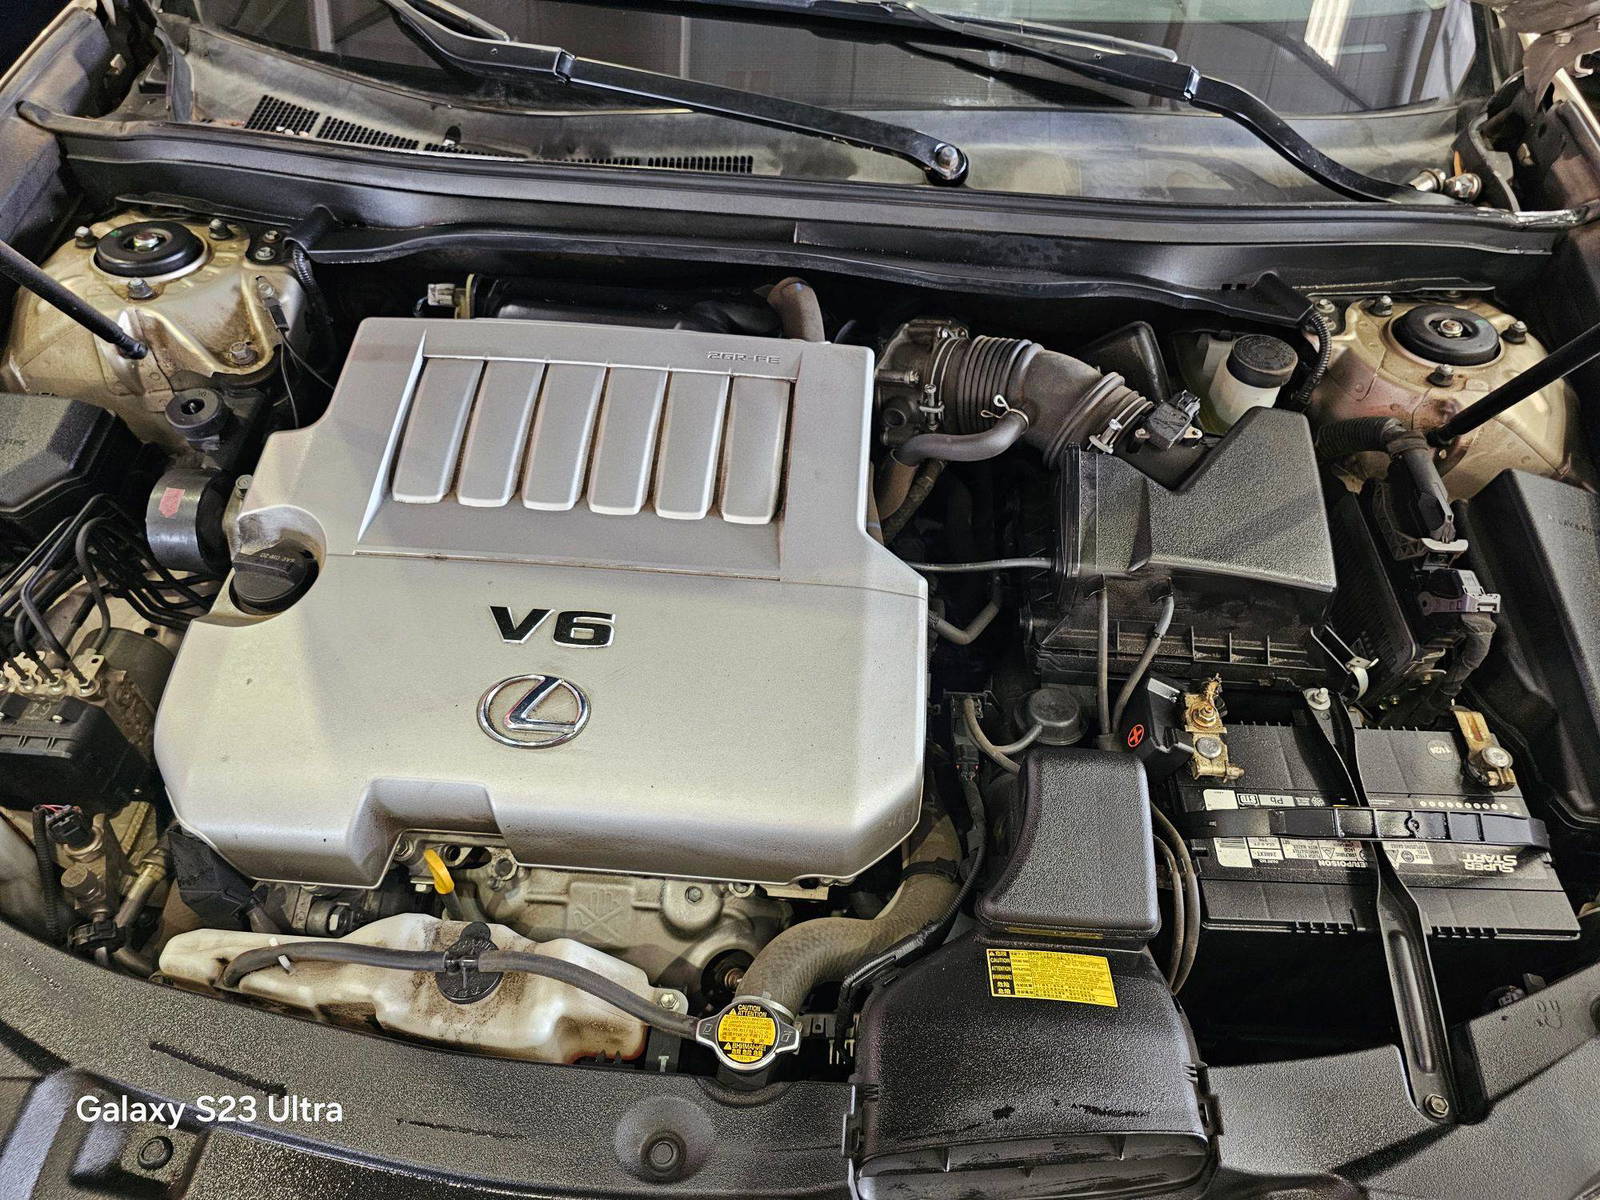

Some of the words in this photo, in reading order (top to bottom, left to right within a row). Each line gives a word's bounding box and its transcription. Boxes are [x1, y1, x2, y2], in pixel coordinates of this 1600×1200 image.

[489, 605, 616, 649] V6
[1466, 853, 1518, 867] START
[1465, 861, 1514, 873] SUPER
[738, 1004, 761, 1012] CAUTION
